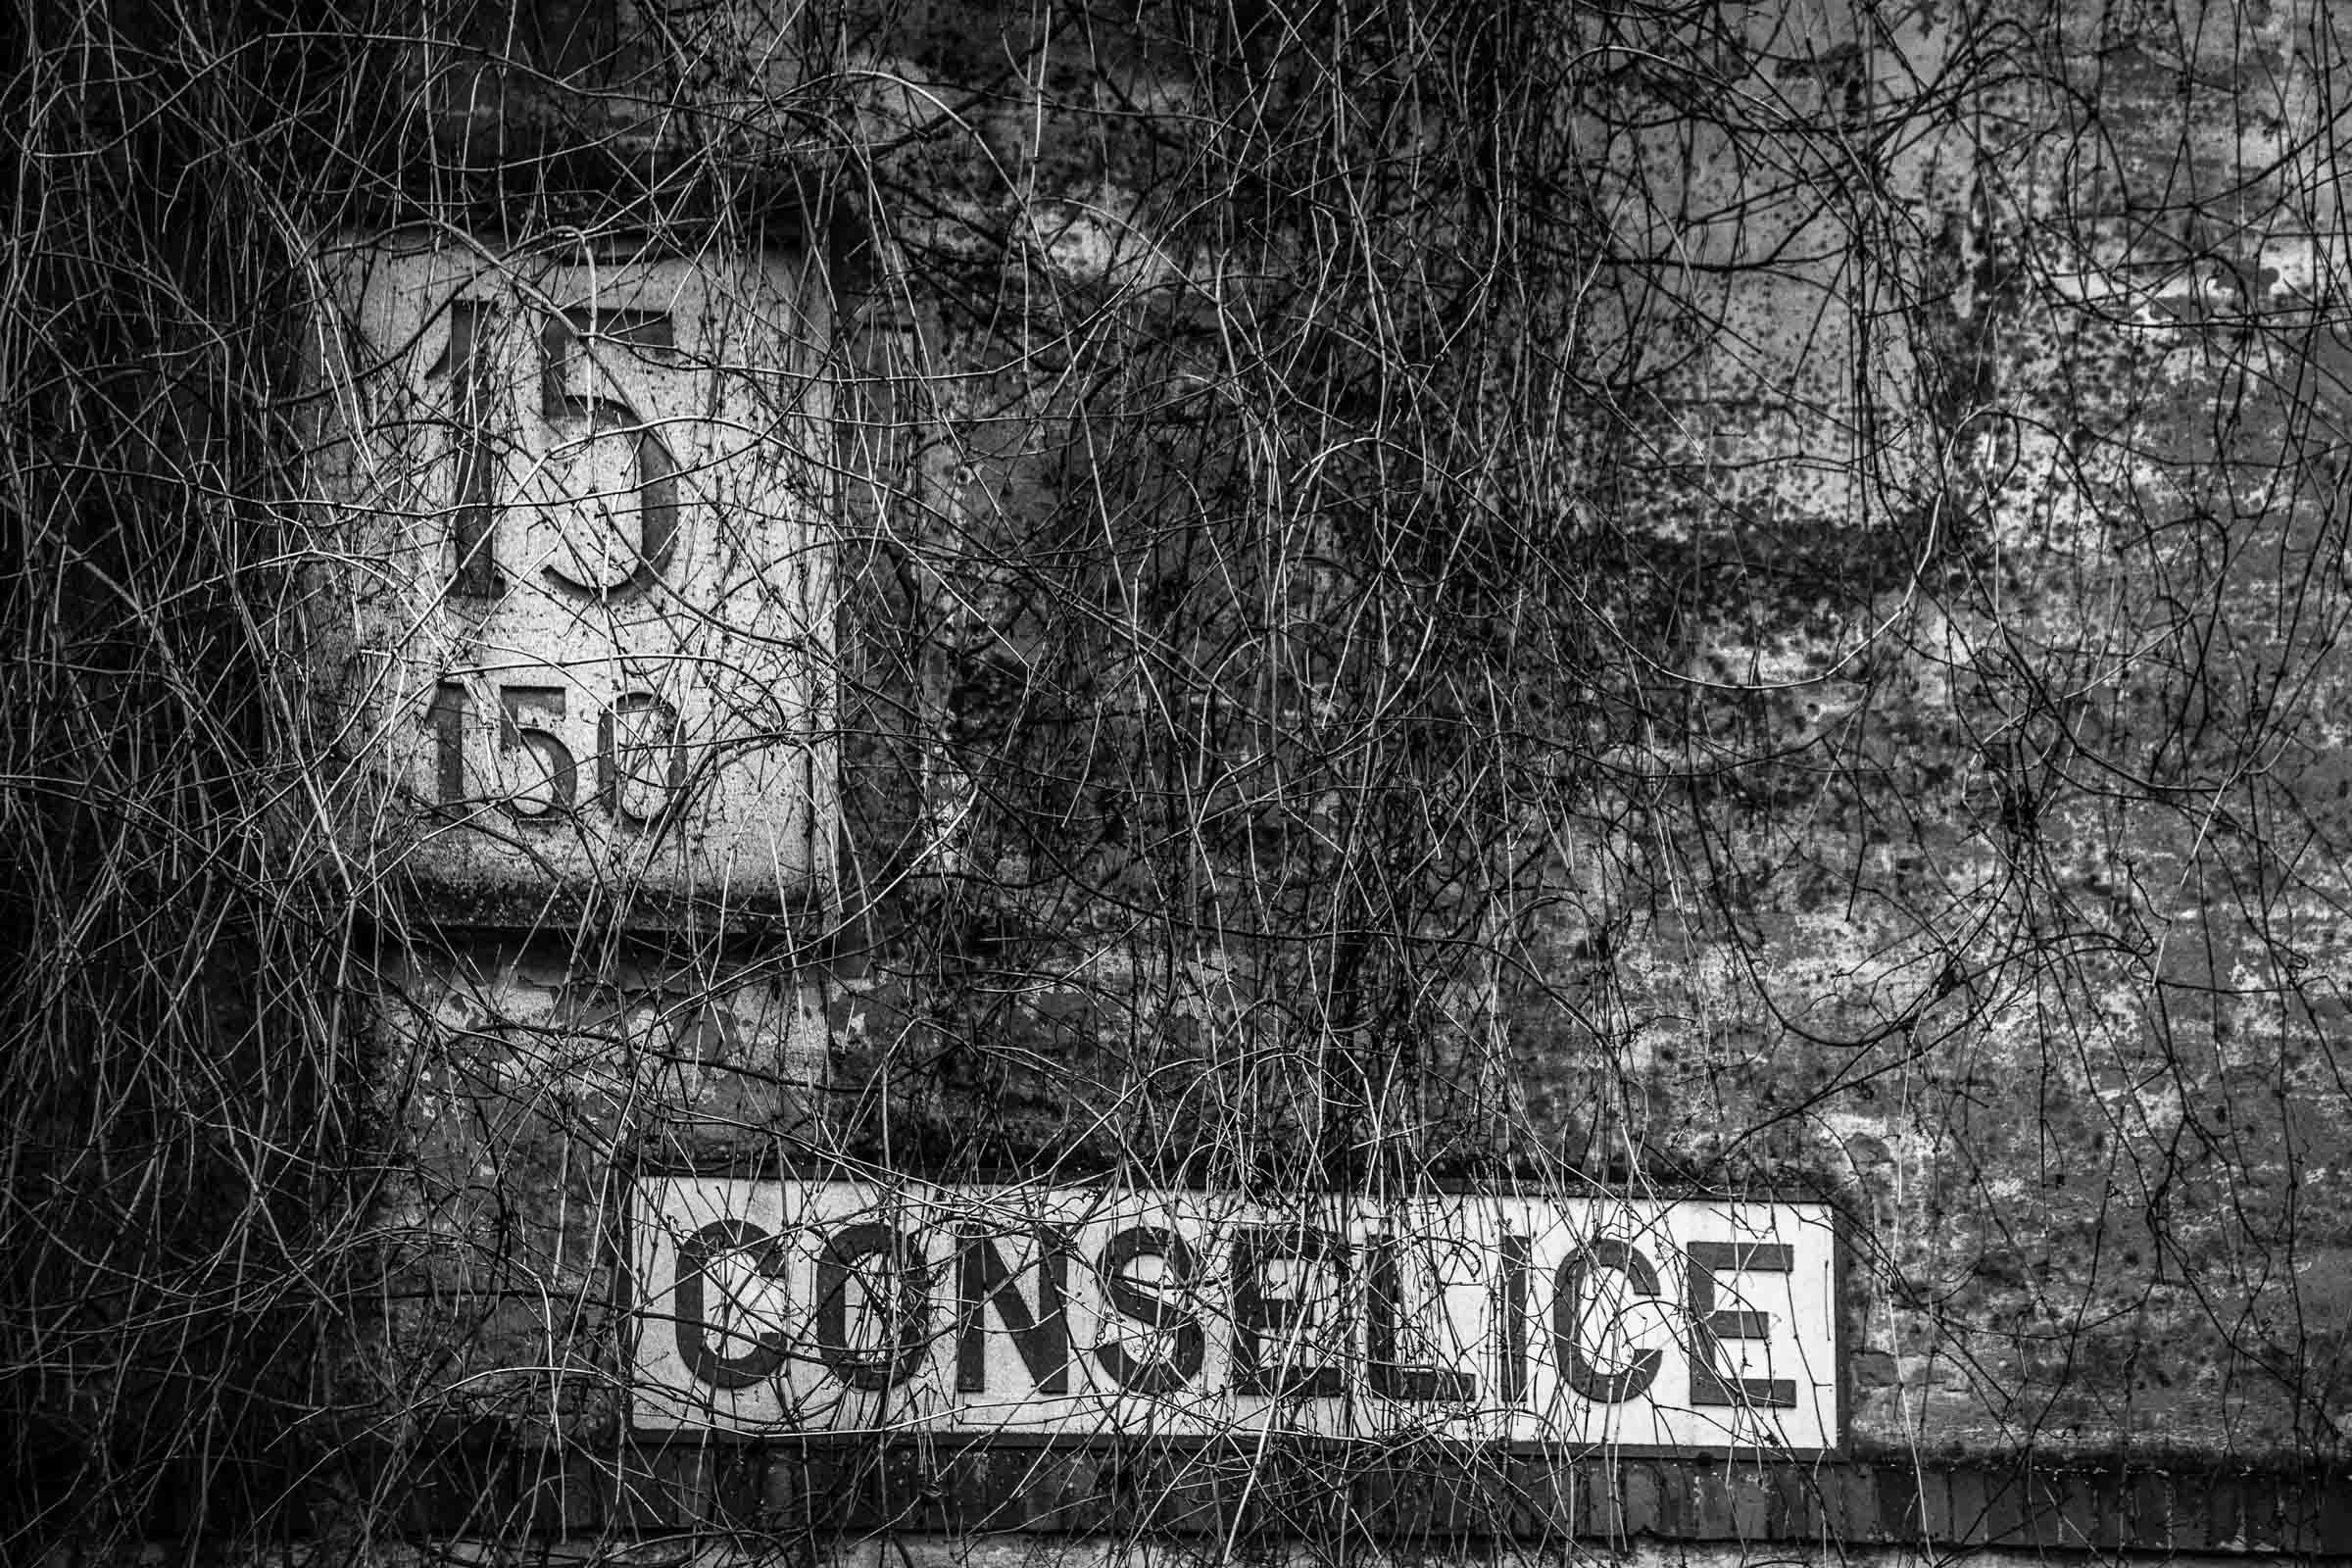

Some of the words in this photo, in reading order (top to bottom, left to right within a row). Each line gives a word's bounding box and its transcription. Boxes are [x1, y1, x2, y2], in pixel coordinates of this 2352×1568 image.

[424, 300, 679, 603] 15
[424, 681, 687, 833] 150
[674, 1219, 1796, 1408] CONSELICE
